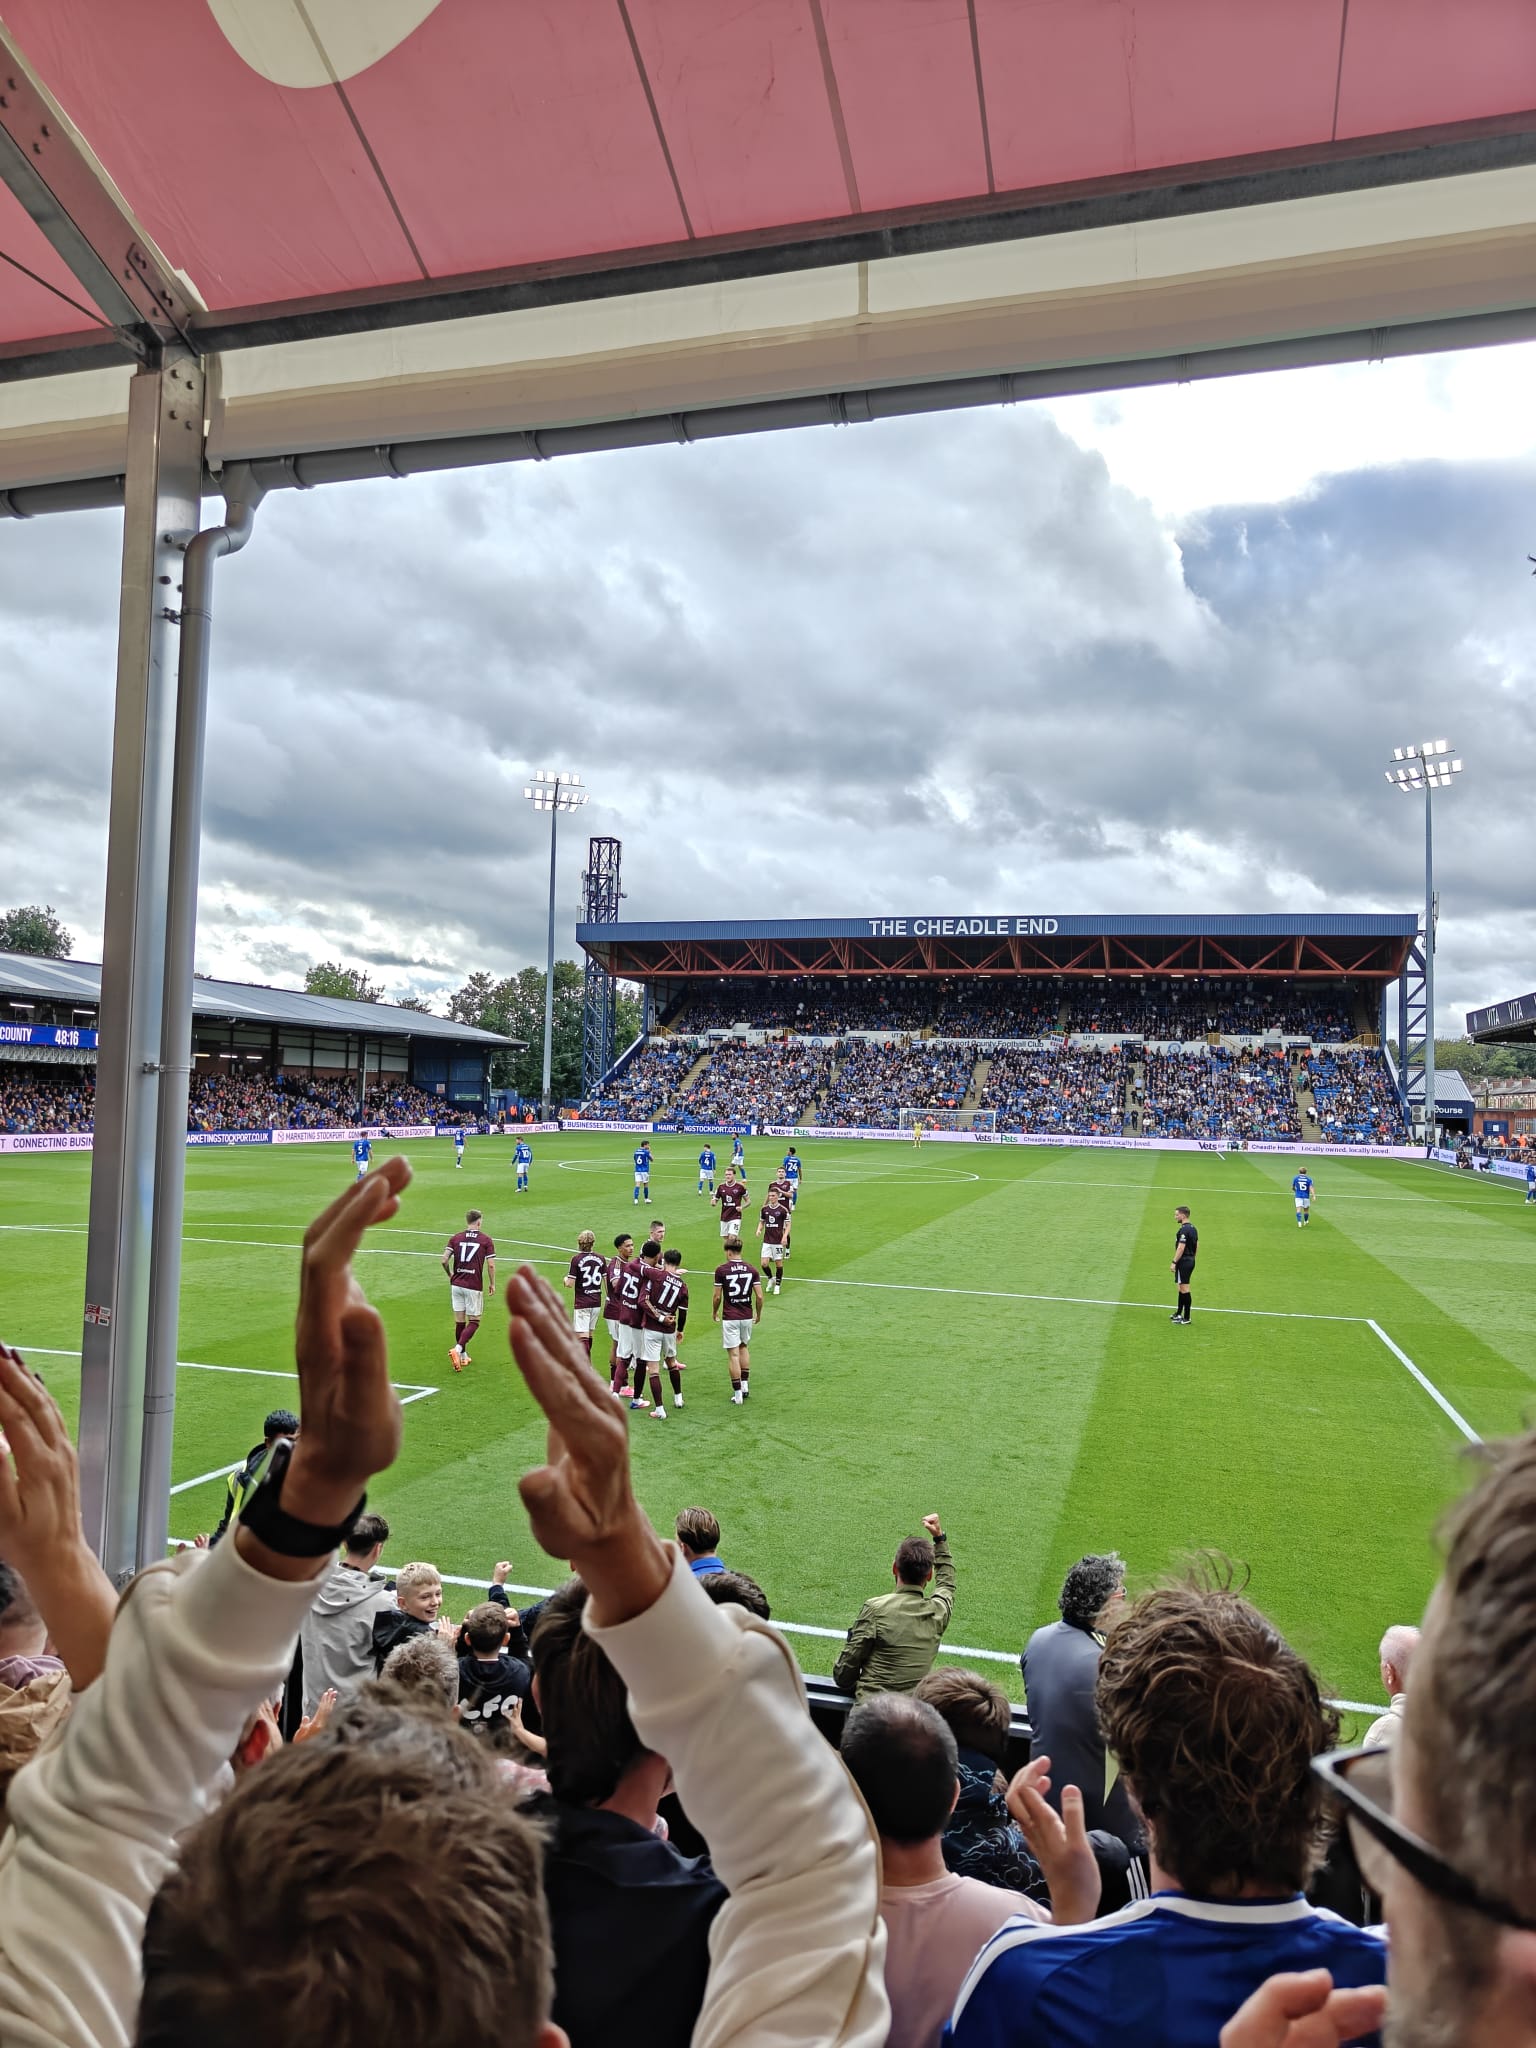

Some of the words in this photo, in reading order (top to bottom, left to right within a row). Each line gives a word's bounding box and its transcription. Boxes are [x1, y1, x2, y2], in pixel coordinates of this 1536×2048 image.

[869, 920, 907, 936] THE
[913, 919, 1009, 936] CHEADLE
[1016, 918, 1059, 935] END
[1508, 1000, 1524, 1021] VITA
[1486, 1007, 1500, 1027] VITA
[0, 1026, 33, 1042] COUNTY
[54, 1029, 79, 1046] 48:16
[971, 1040, 997, 1048] County
[998, 1040, 1027, 1048] Football
[1027, 1040, 1044, 1048] Club
[567, 1121, 604, 1129] BUSINESSES
[612, 1123, 648, 1131] STOCKPORT
[186, 1132, 269, 1144] ARKETINGSTOCKPORT.CO.UK
[285, 1132, 317, 1142] MARKETING
[317, 1131, 345, 1140] STOCKPORT
[974, 1133, 992, 1142] Vets
[1001, 1134, 1018, 1143] Pets
[13, 1137, 68, 1149] CONNECTING
[1198, 1141, 1218, 1151] Vets
[1301, 1145, 1324, 1153] Locally
[1348, 1147, 1371, 1155] locally
[357, 1145, 363, 1154] 5
[636, 1154, 643, 1165] 6
[703, 1157, 710, 1166] 4
[787, 1162, 798, 1172] 24
[1298, 1181, 1307, 1191] 15
[459, 1241, 480, 1262] 17
[580, 1265, 602, 1288] 36
[621, 1272, 640, 1299] 25
[725, 1273, 753, 1297] 37
[657, 1280, 681, 1308] 11
